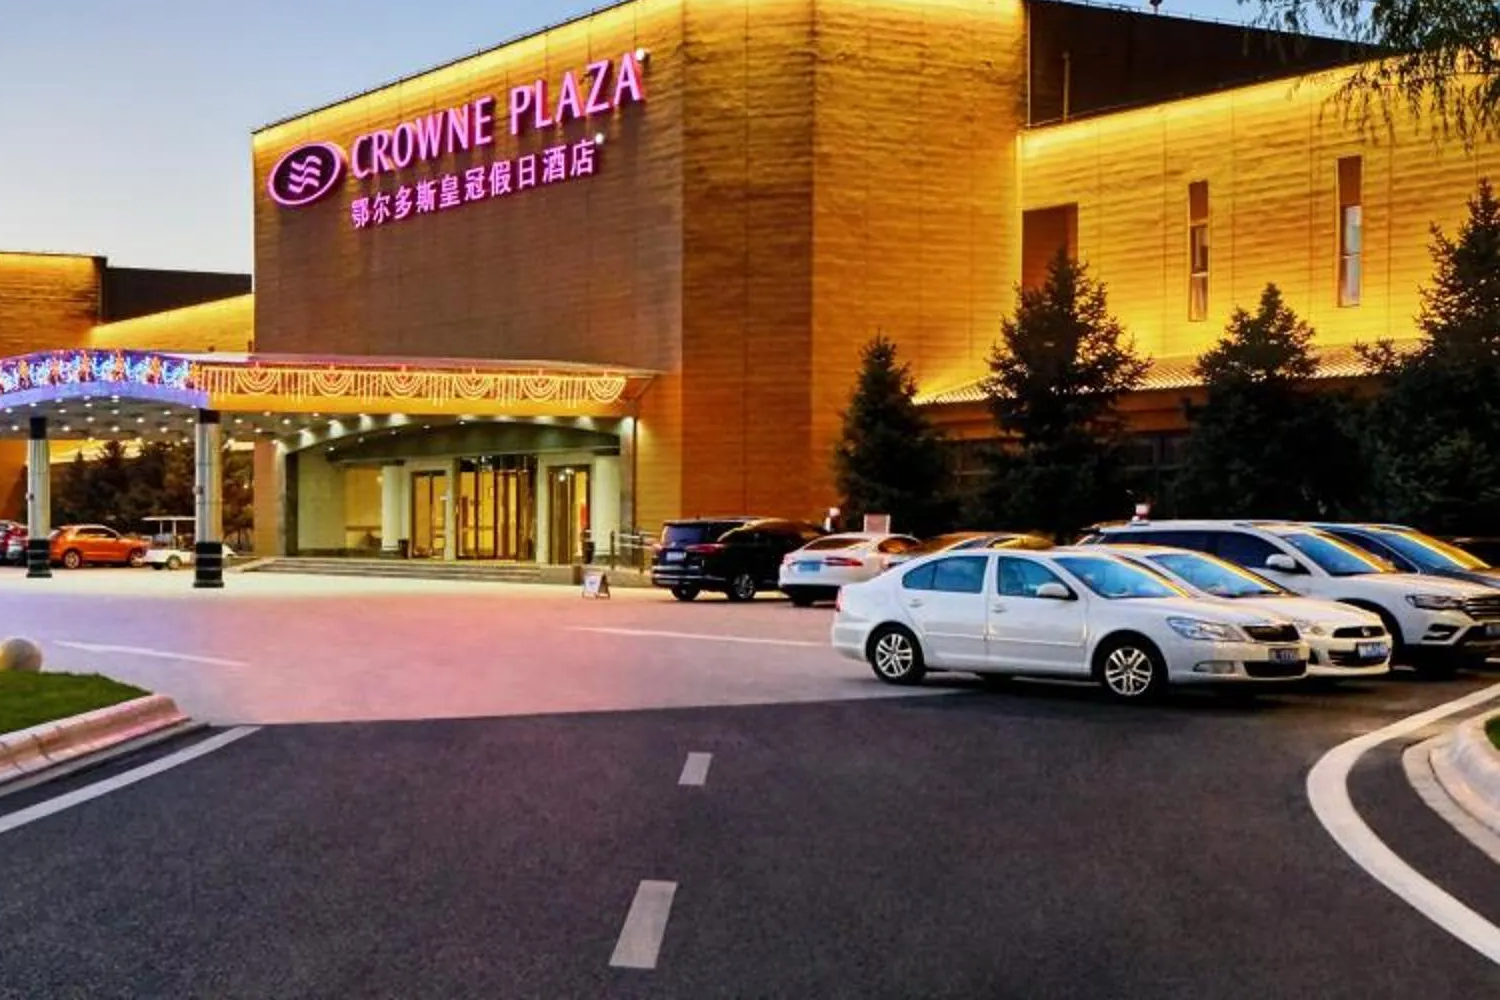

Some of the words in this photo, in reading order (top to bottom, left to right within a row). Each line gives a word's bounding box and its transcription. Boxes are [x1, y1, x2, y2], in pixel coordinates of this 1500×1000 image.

[351, 96, 495, 179] CROWNE
[510, 51, 643, 136] PLAZA
[351, 139, 596, 228] 鄂尔多斯皇冠假日酒店
